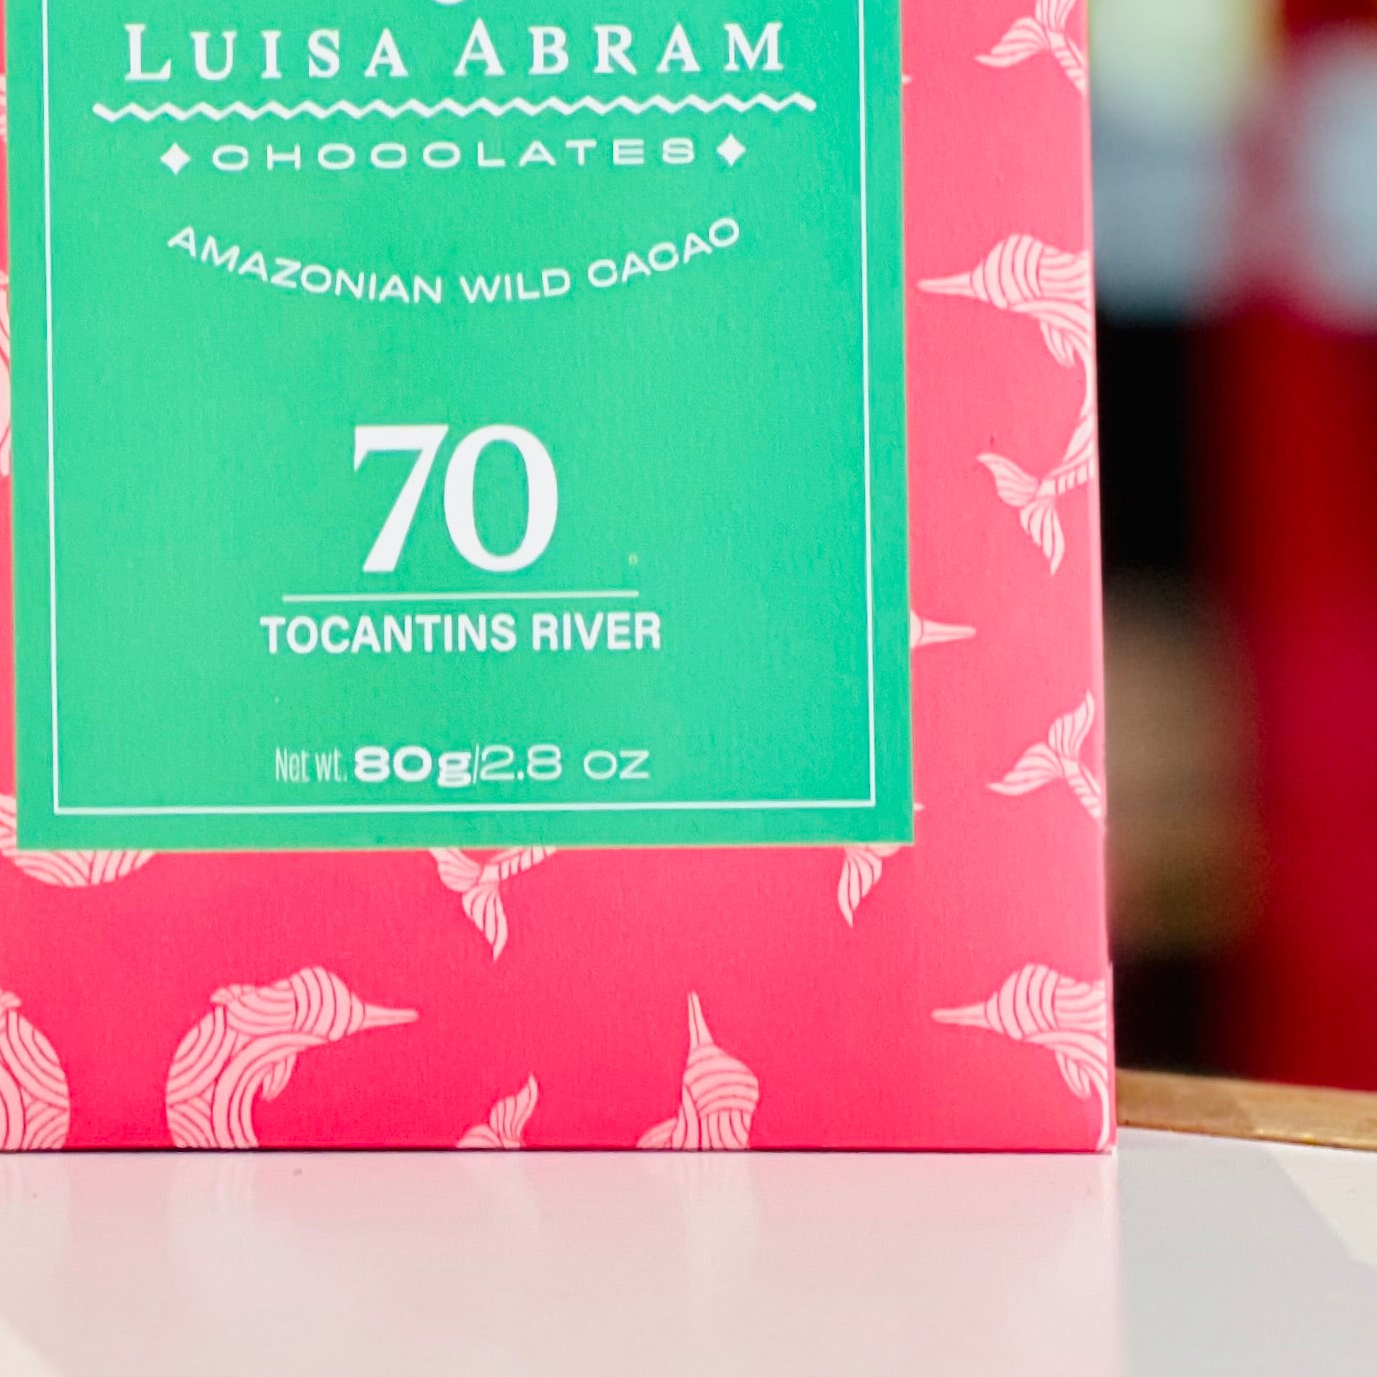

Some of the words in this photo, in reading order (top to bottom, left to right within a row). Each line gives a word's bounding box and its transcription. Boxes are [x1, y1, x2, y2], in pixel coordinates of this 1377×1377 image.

[123, 23, 409, 82] LUISA
[453, 17, 784, 78] ABRAM
[211, 137, 696, 172] CHOCOLATES
[167, 226, 443, 305] AMAZONIAN
[459, 267, 572, 304] WILD
[586, 217, 741, 289] CACAO
[353, 424, 559, 572] 70
[259, 613, 518, 654] TOCANTINS
[531, 611, 662, 651] RIVER
[275, 747, 310, 783] Net
[314, 748, 348, 782] wt.
[582, 749, 650, 780] oz
